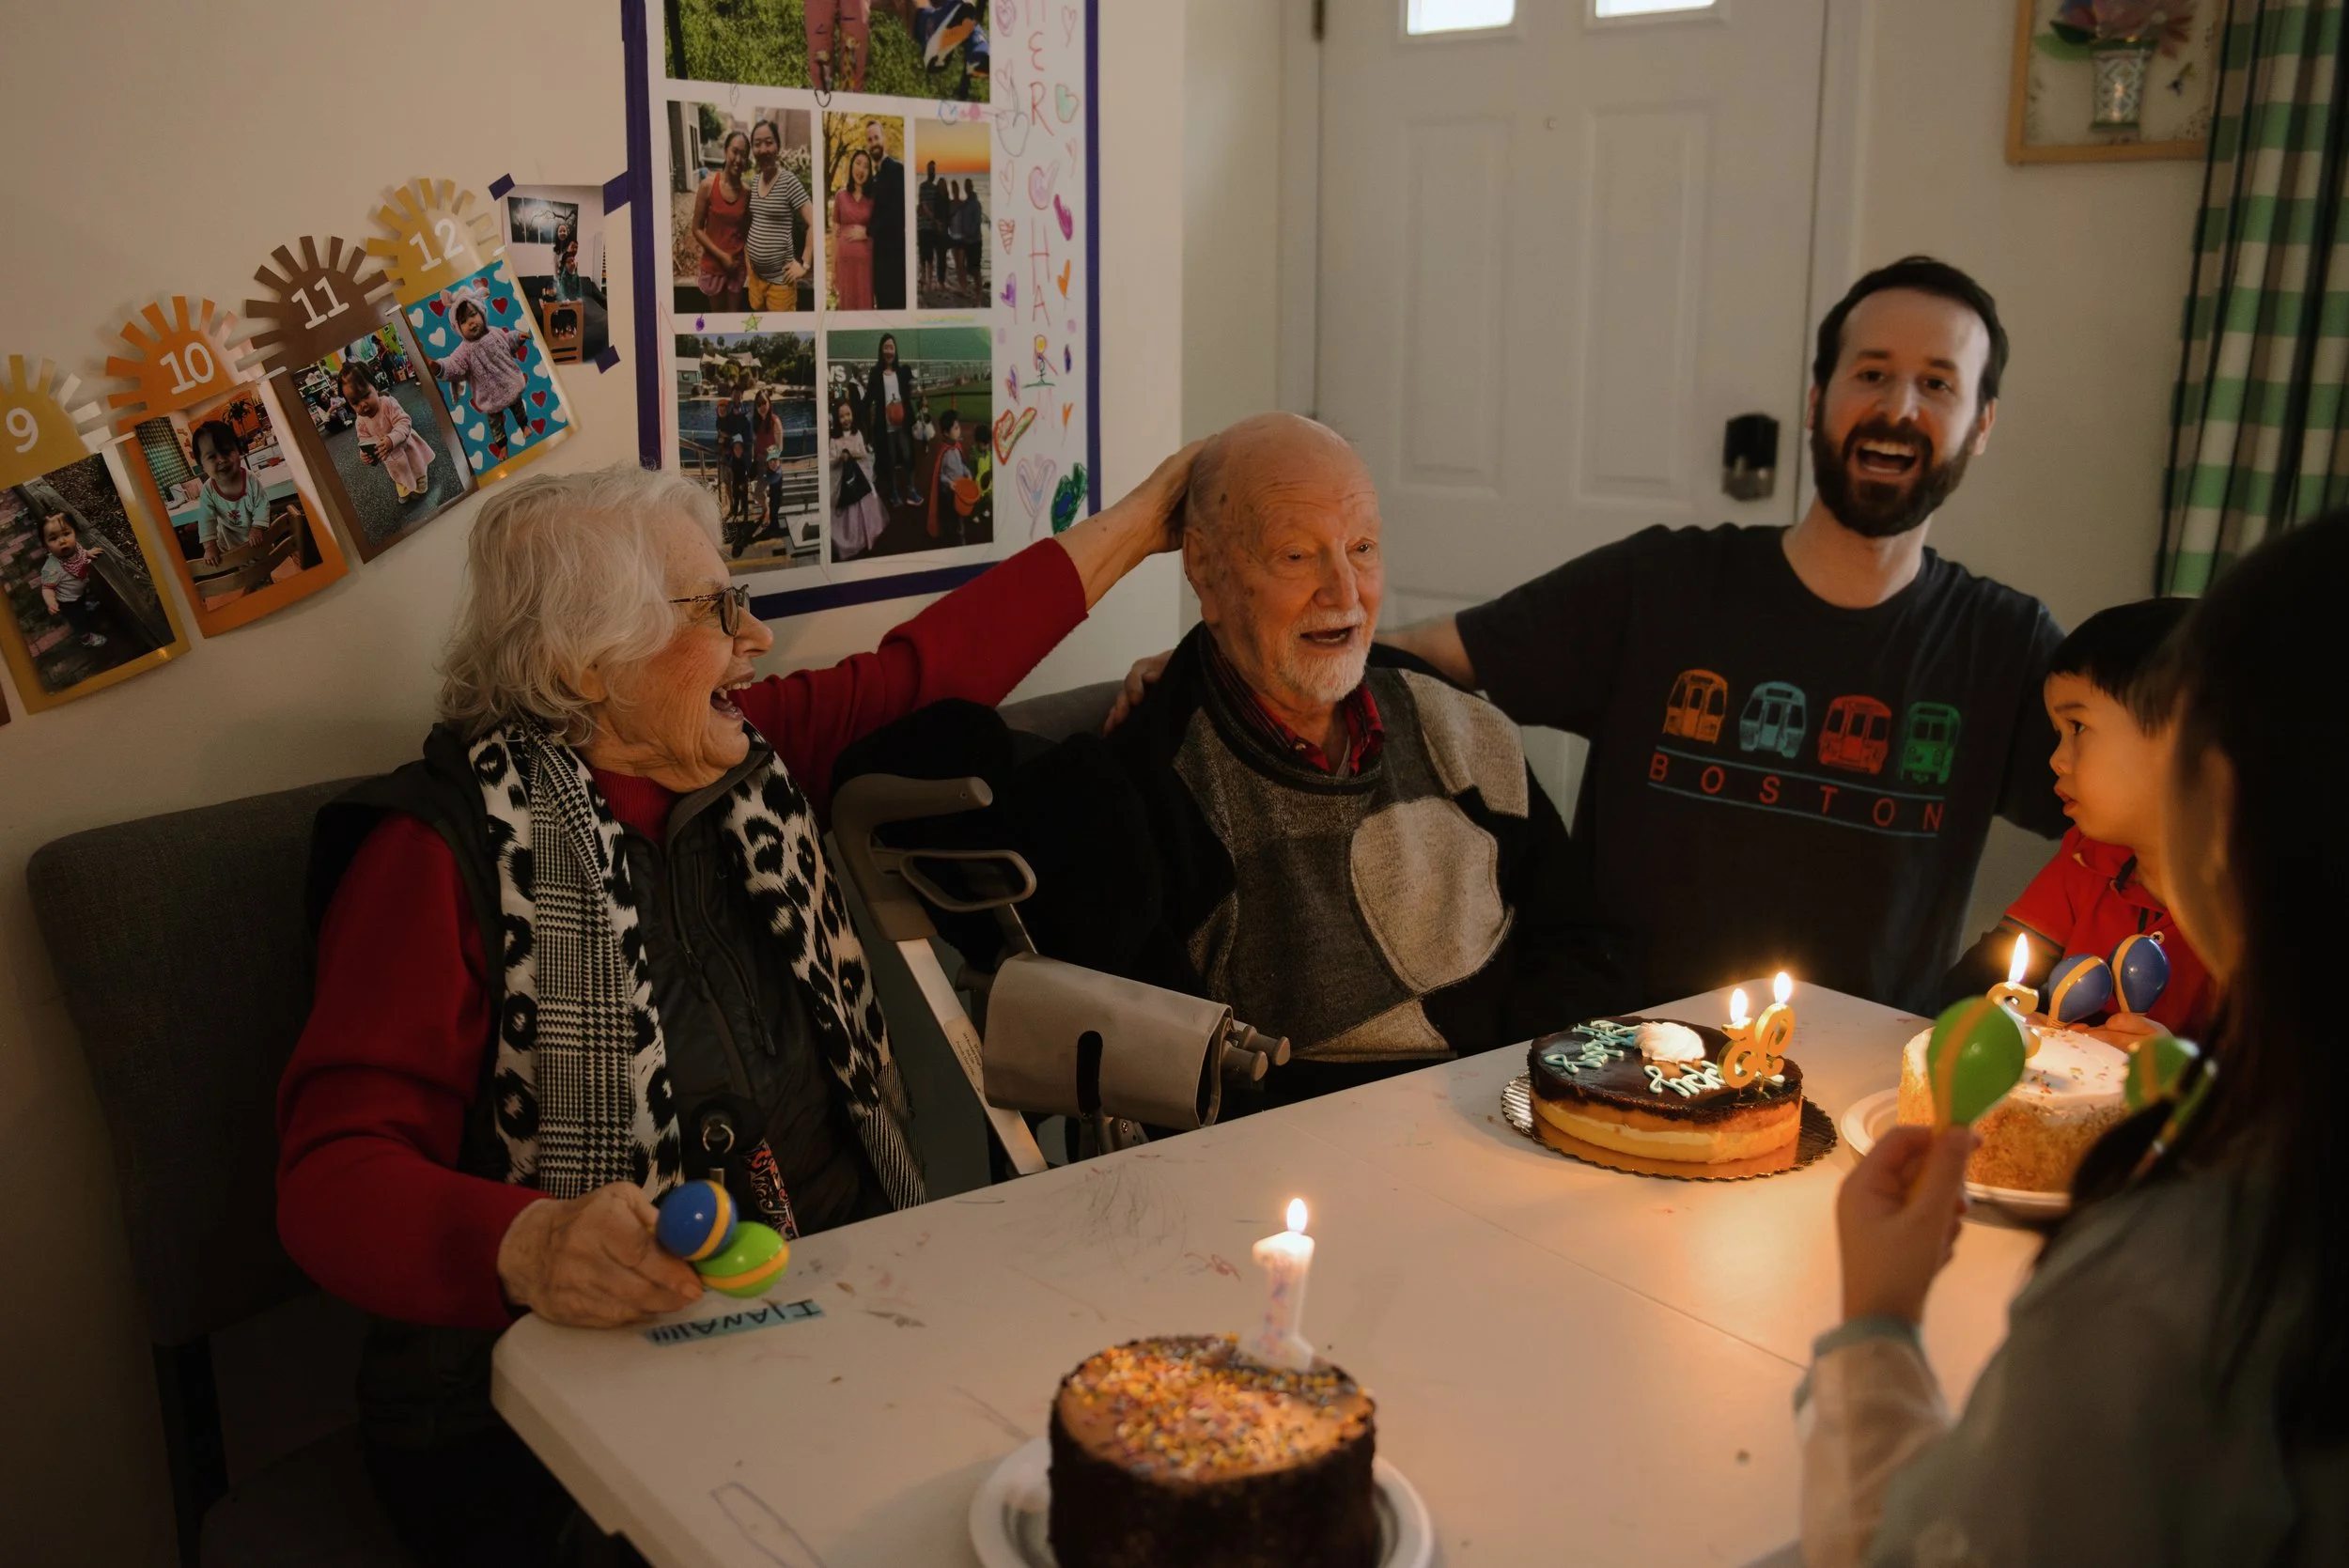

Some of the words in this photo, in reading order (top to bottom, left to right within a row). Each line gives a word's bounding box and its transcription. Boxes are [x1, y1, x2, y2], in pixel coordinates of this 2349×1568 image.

[409, 218, 465, 272] 12
[291, 275, 350, 329] 11
[160, 342, 214, 394] 10
[6, 407, 39, 453] 9
[1648, 753, 1944, 831] BOSTON
